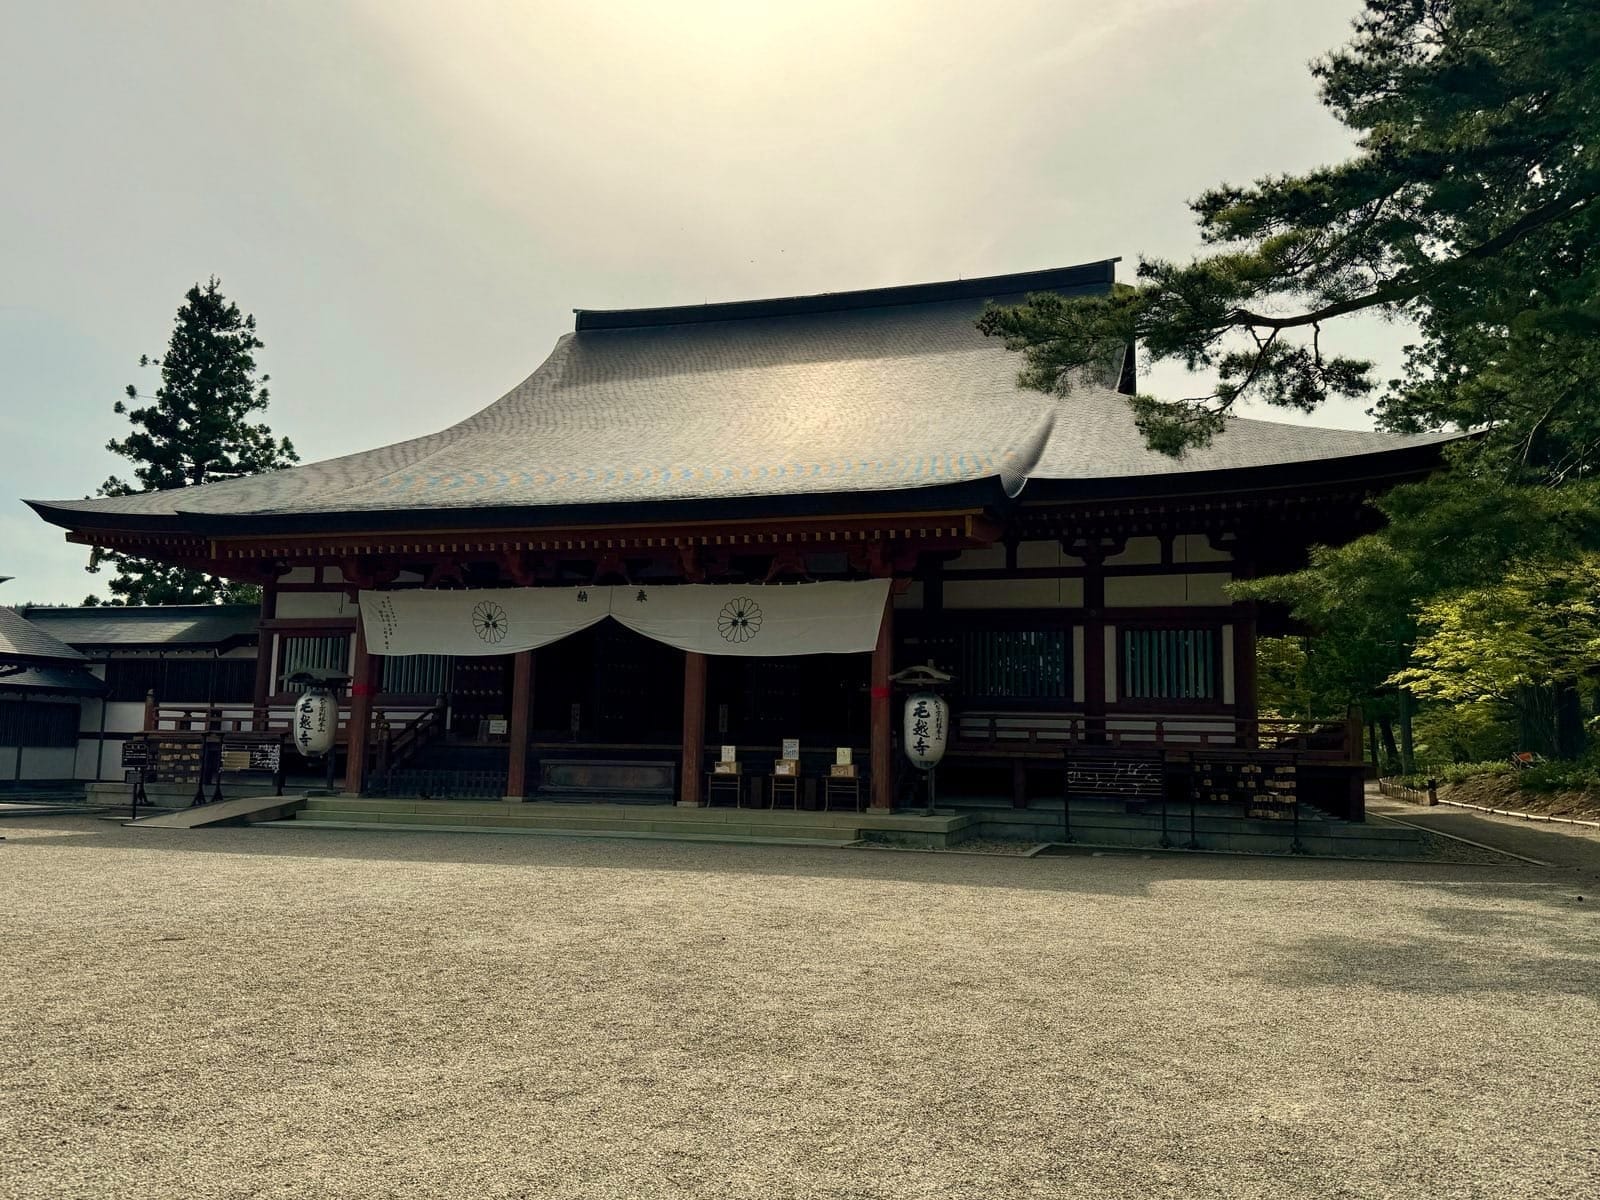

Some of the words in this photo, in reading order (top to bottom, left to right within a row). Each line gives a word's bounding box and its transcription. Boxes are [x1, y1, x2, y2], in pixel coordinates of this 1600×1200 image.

[299, 698, 313, 747] 毛越寺
[913, 701, 930, 756] 毛越寺
